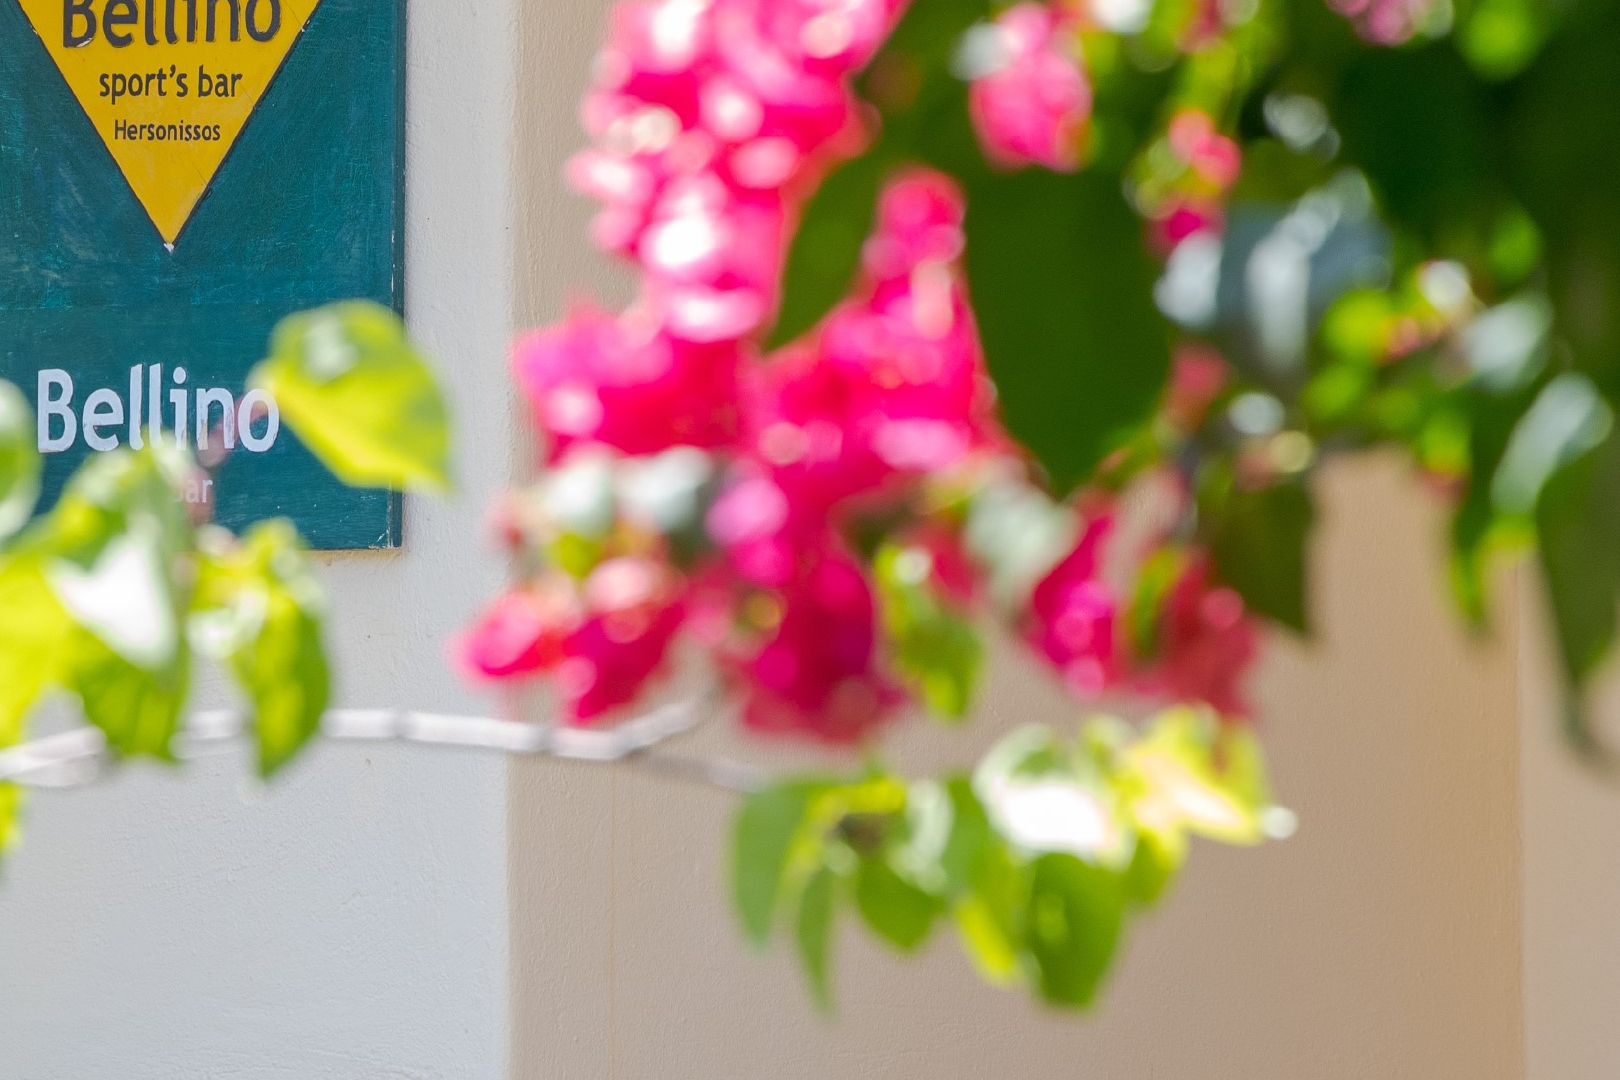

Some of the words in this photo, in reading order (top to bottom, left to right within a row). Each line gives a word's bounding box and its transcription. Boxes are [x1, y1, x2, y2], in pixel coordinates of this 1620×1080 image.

[198, 65, 243, 97] bar
[115, 120, 220, 141] Hersonissos
[37, 364, 279, 452] Bellino
